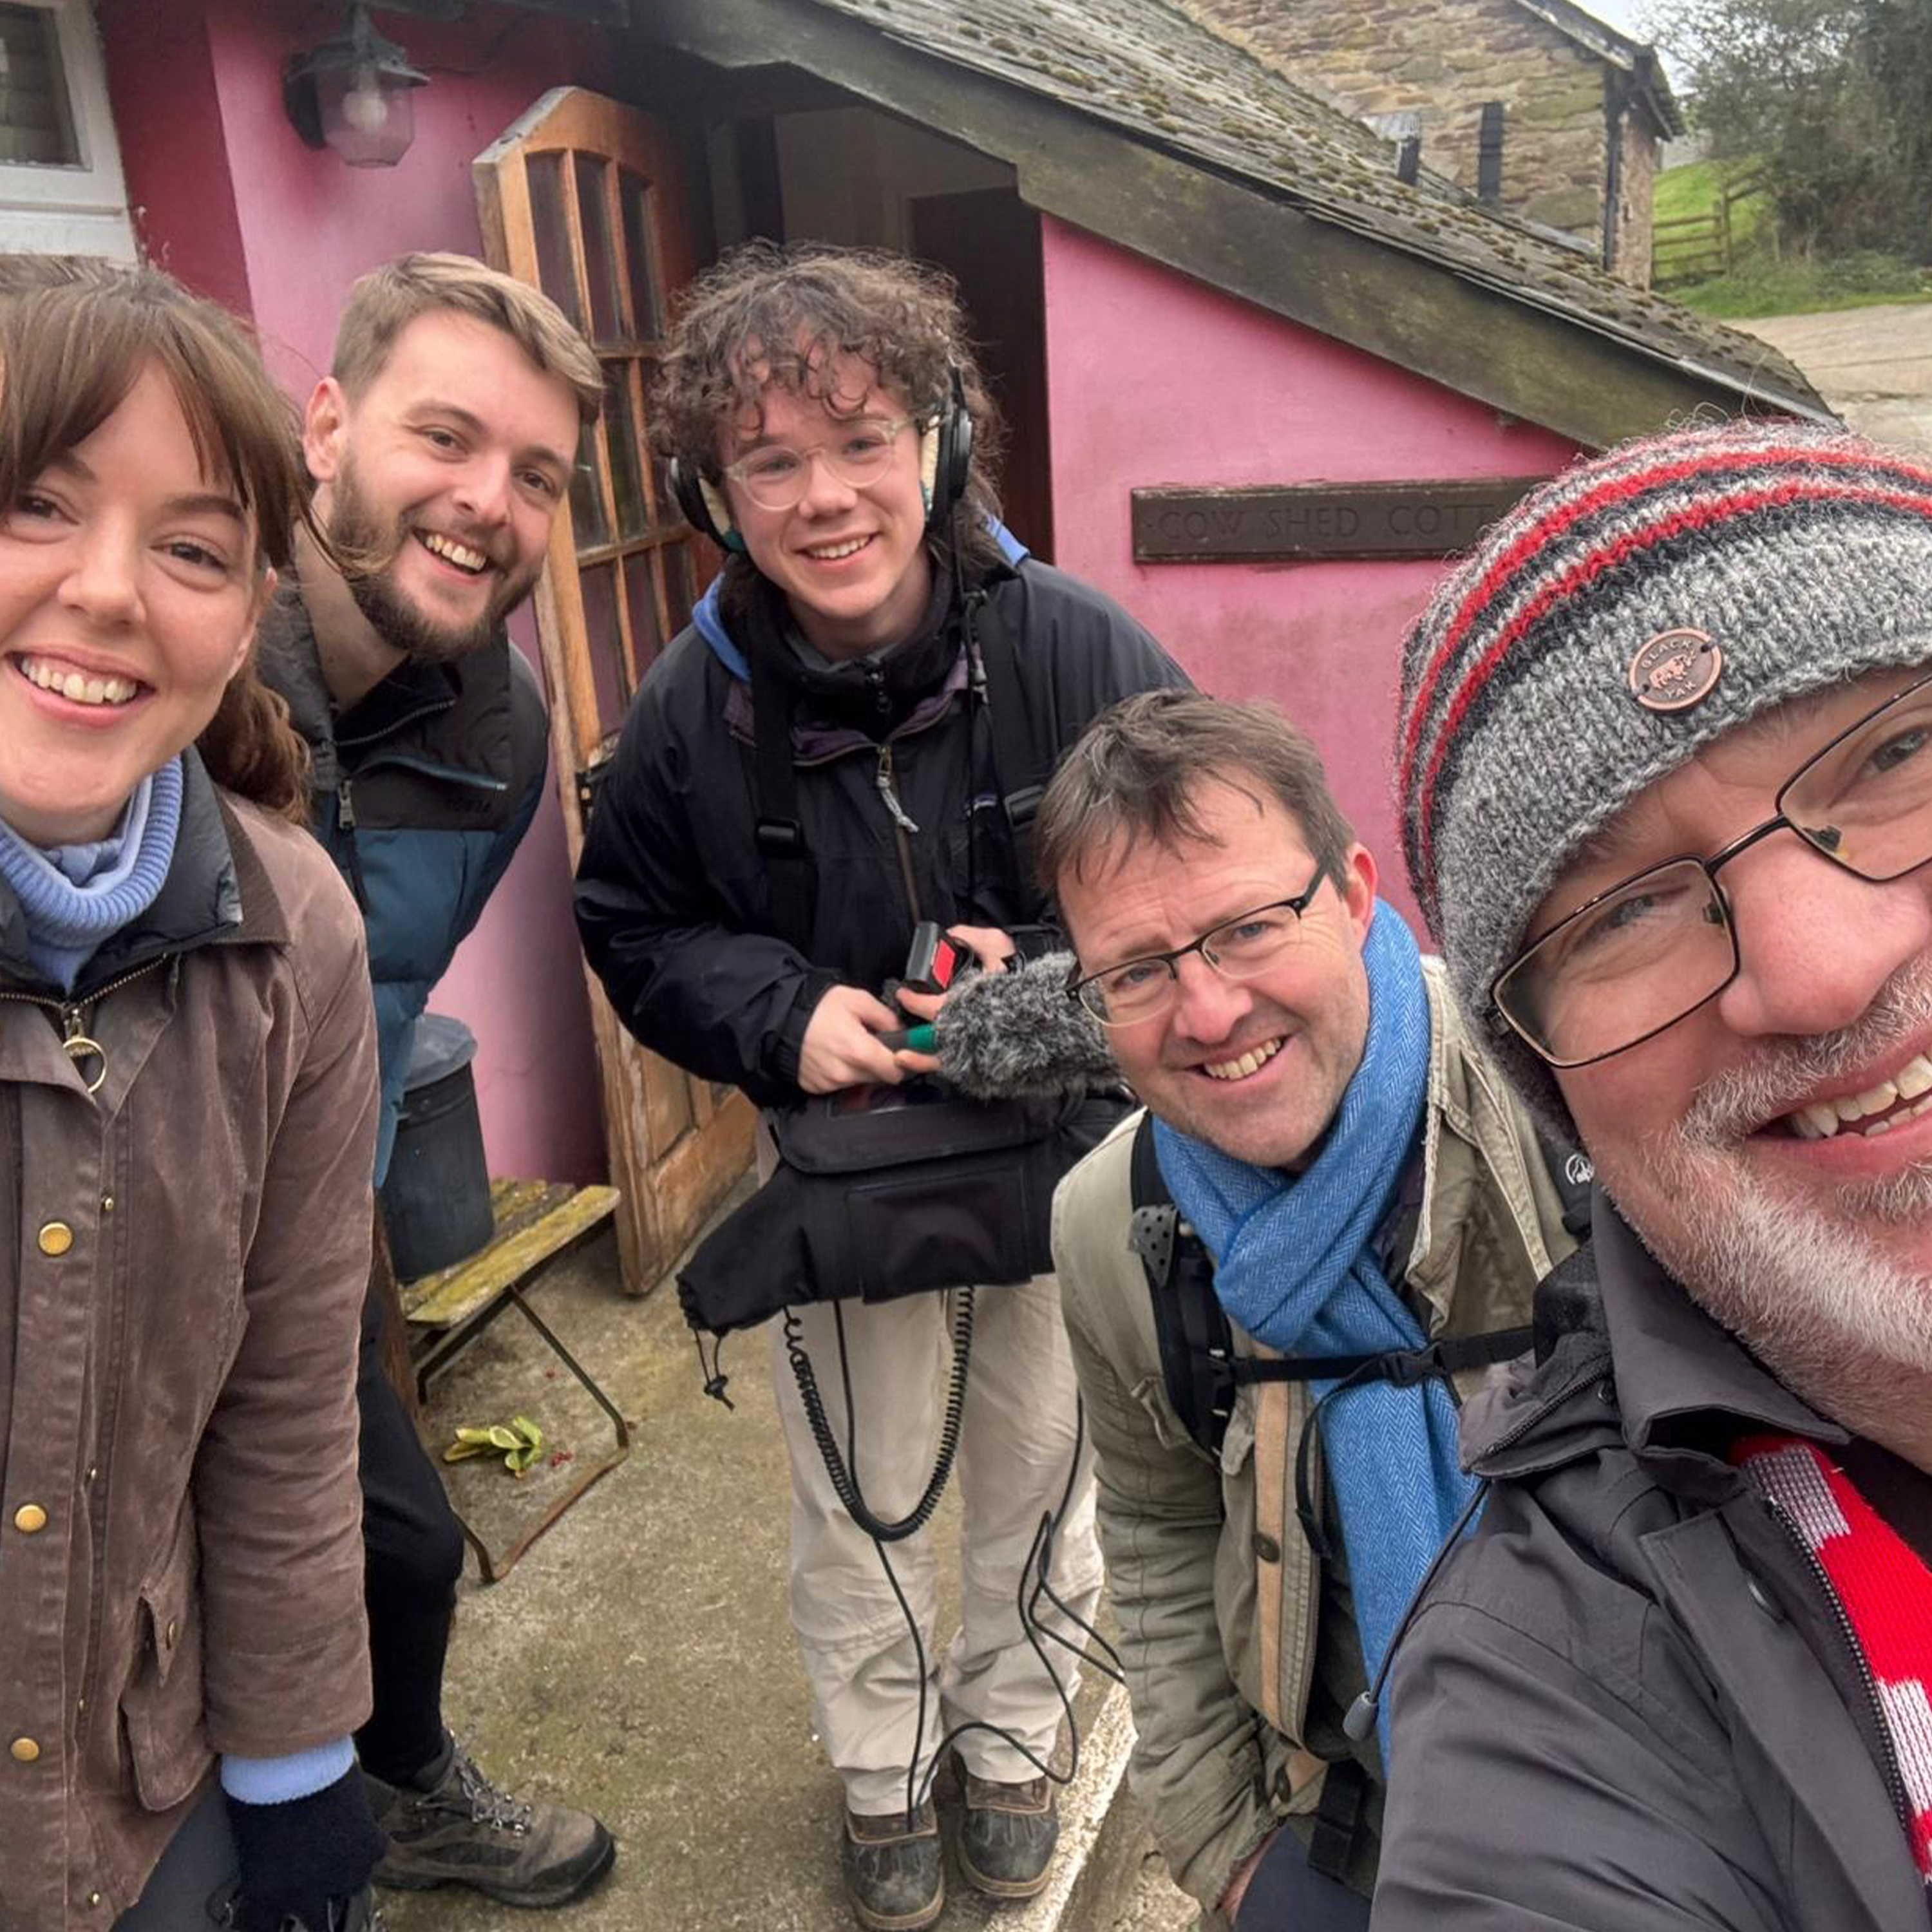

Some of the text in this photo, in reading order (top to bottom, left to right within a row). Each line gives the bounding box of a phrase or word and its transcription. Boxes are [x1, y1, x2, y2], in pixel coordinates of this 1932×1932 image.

[1159, 509, 1245, 540] COW
[1266, 507, 1359, 537] SHED
[1642, 639, 1692, 668] BLACK
[1666, 681, 1696, 698] YAK
